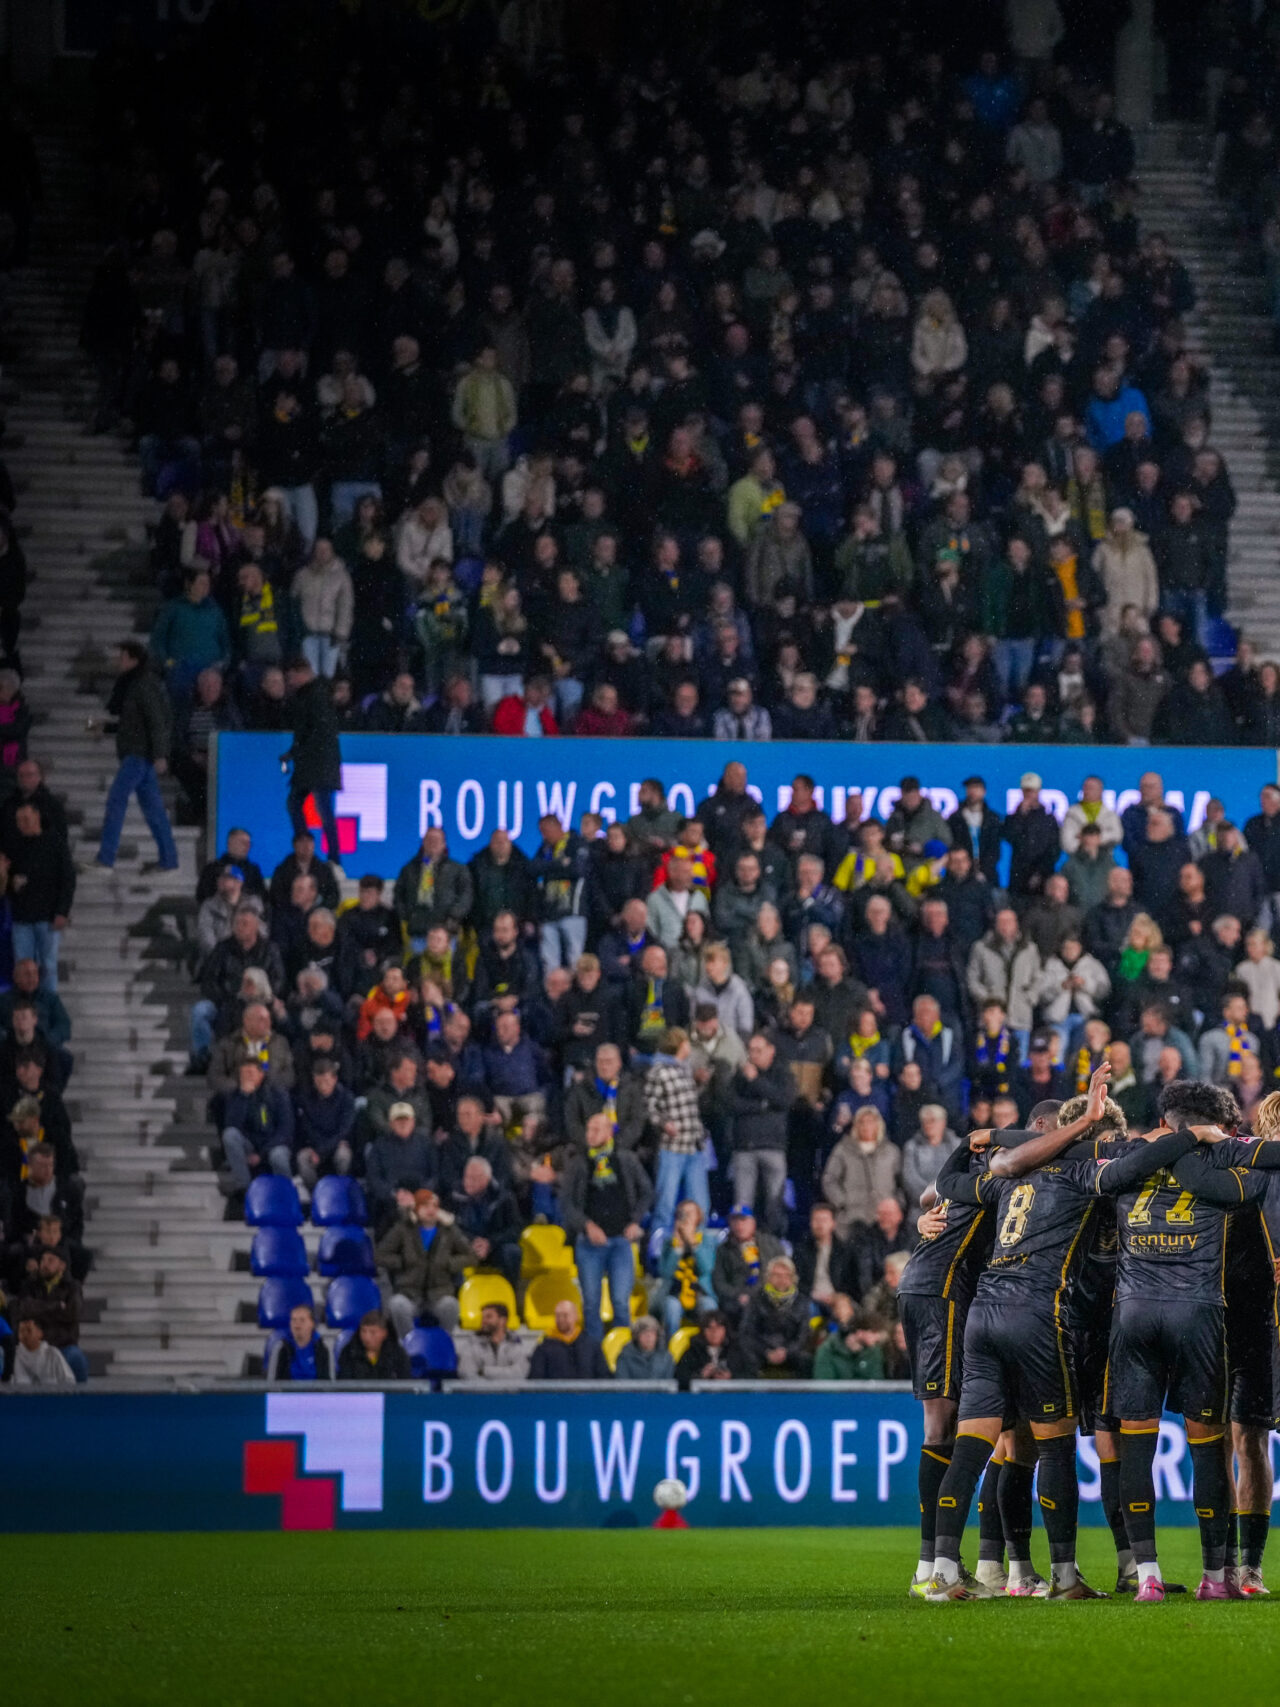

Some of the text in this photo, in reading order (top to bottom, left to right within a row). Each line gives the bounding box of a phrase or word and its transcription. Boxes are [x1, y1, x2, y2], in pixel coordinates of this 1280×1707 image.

[419, 778, 763, 841] BOUWGO
[1000, 1184, 1036, 1248] 8
[1129, 1232, 1199, 1250] century
[423, 1418, 908, 1503] BOUWGROEP
